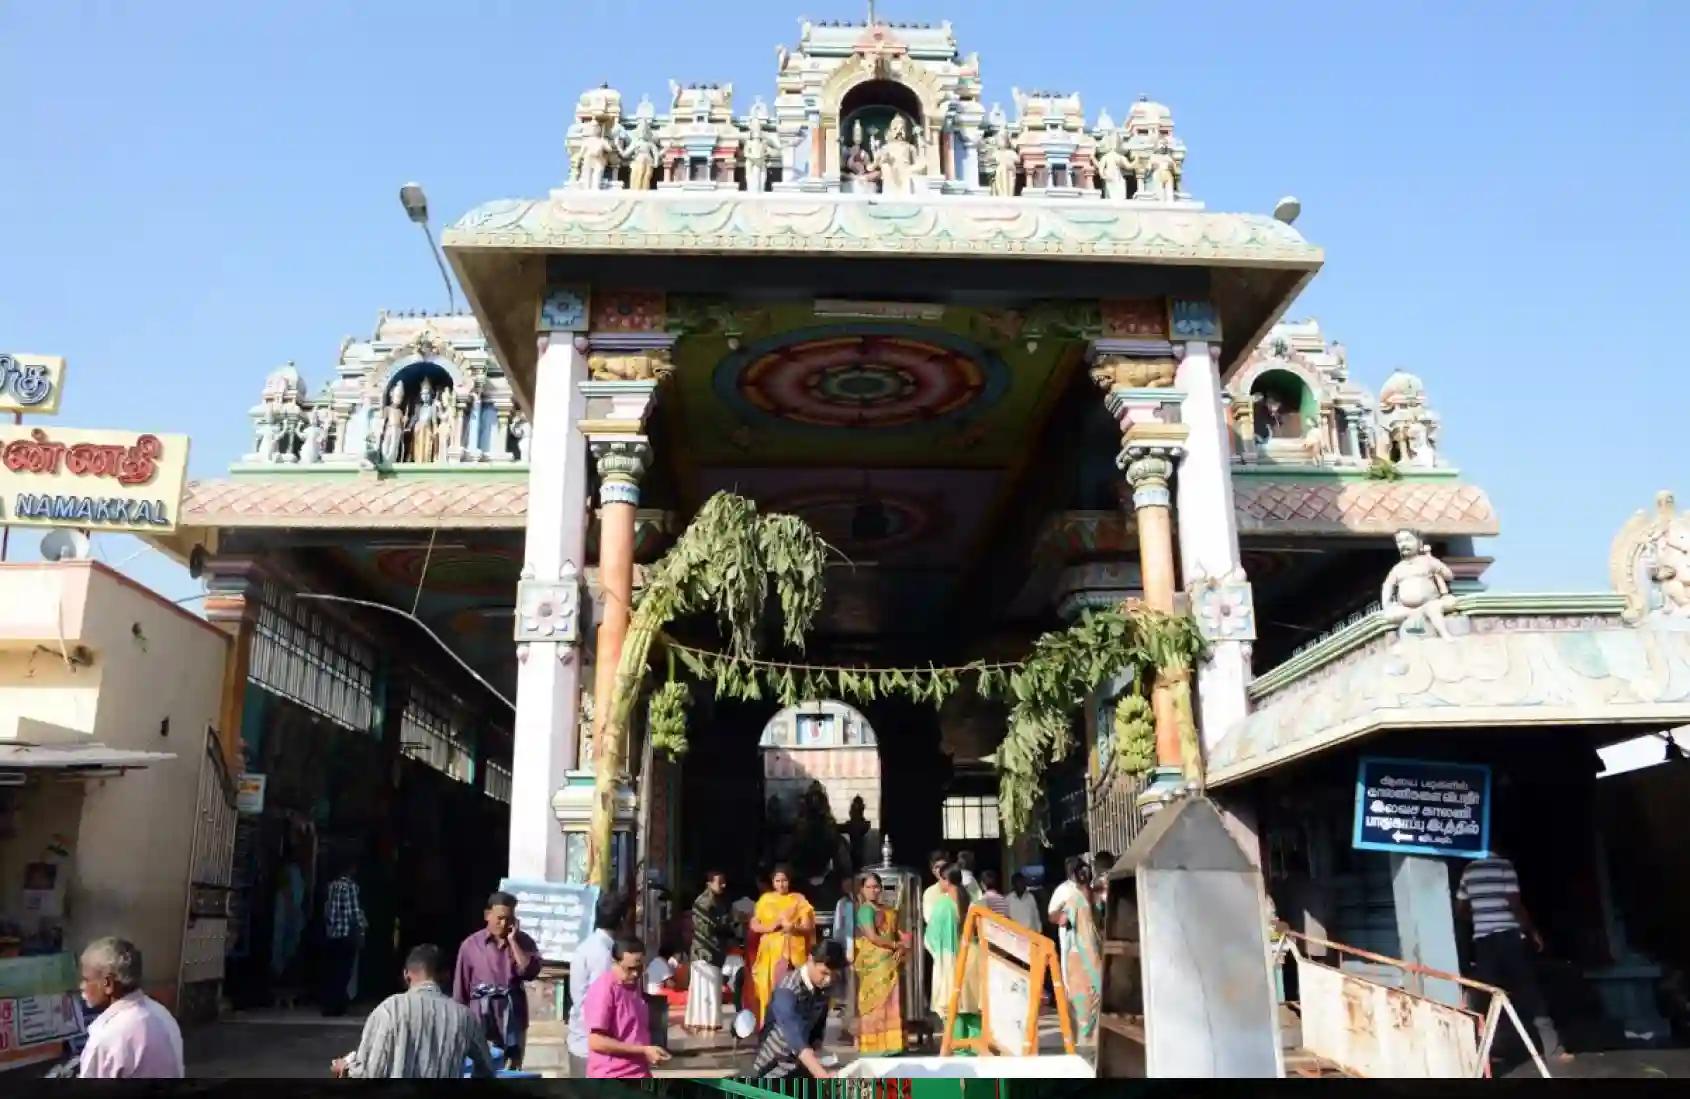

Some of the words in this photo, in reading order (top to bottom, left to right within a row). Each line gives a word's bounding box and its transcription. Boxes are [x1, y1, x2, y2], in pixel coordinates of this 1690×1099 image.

[0, 429, 161, 485] ன்னதி
[16, 494, 168, 524] NAMAKKAL
[1365, 816, 1425, 832] பாதுகாப்பு
[1426, 818, 1480, 836] இடத்தில்
